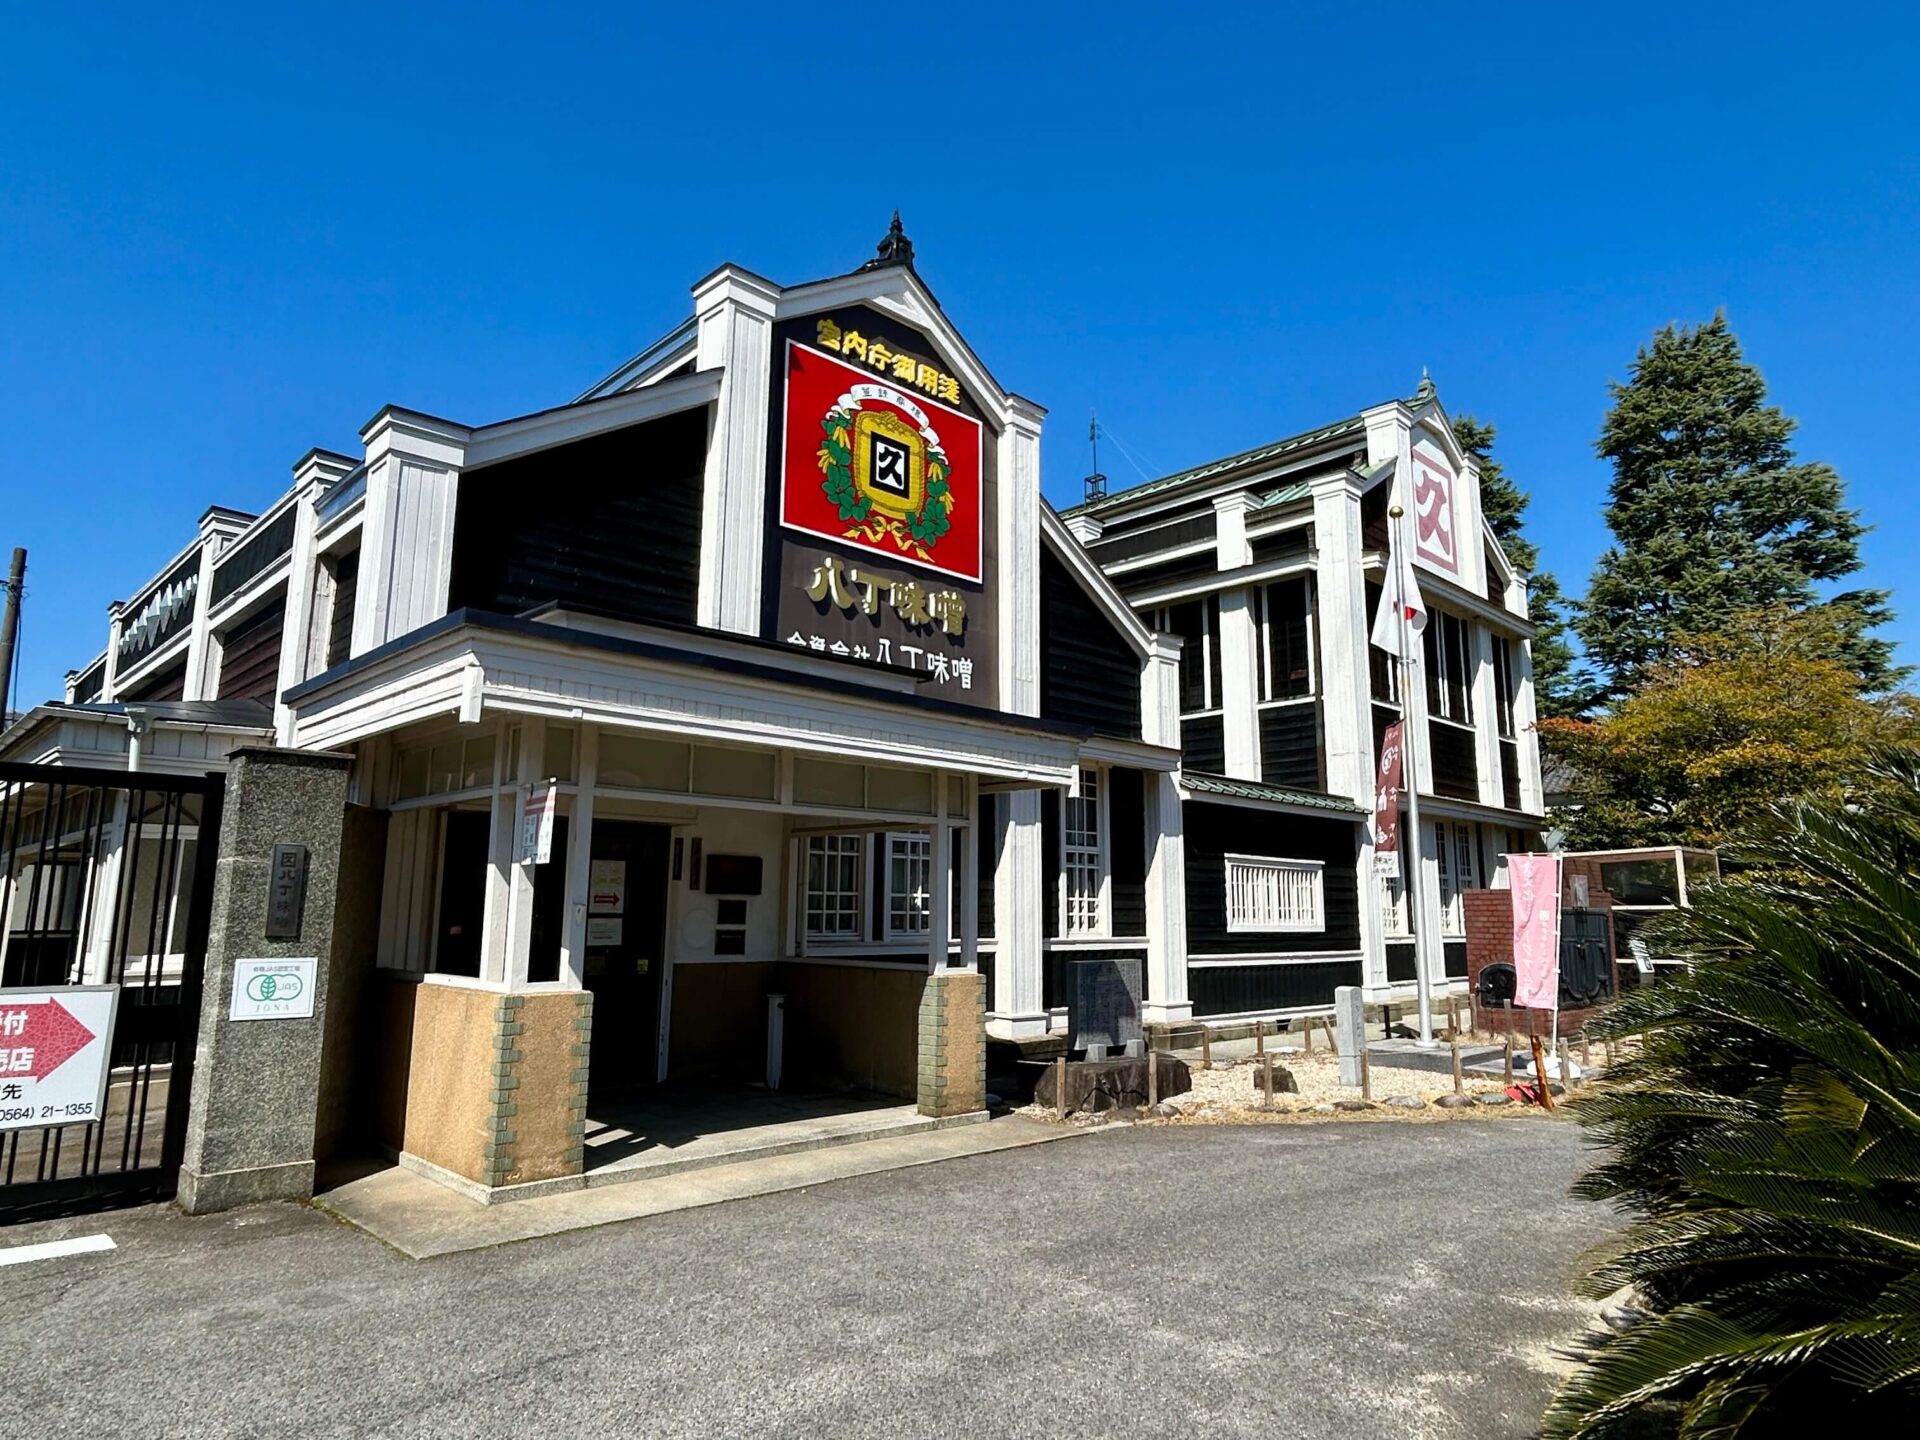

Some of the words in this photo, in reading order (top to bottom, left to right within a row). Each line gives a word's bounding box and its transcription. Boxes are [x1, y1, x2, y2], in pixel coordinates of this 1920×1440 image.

[816, 318, 962, 406] 宮内庁御用達
[878, 446, 904, 488] 久
[807, 556, 967, 637] 八丁味噌
[277, 982, 299, 991] JAS
[0, 1009, 29, 1037] 付
[0, 1083, 23, 1101] 先
